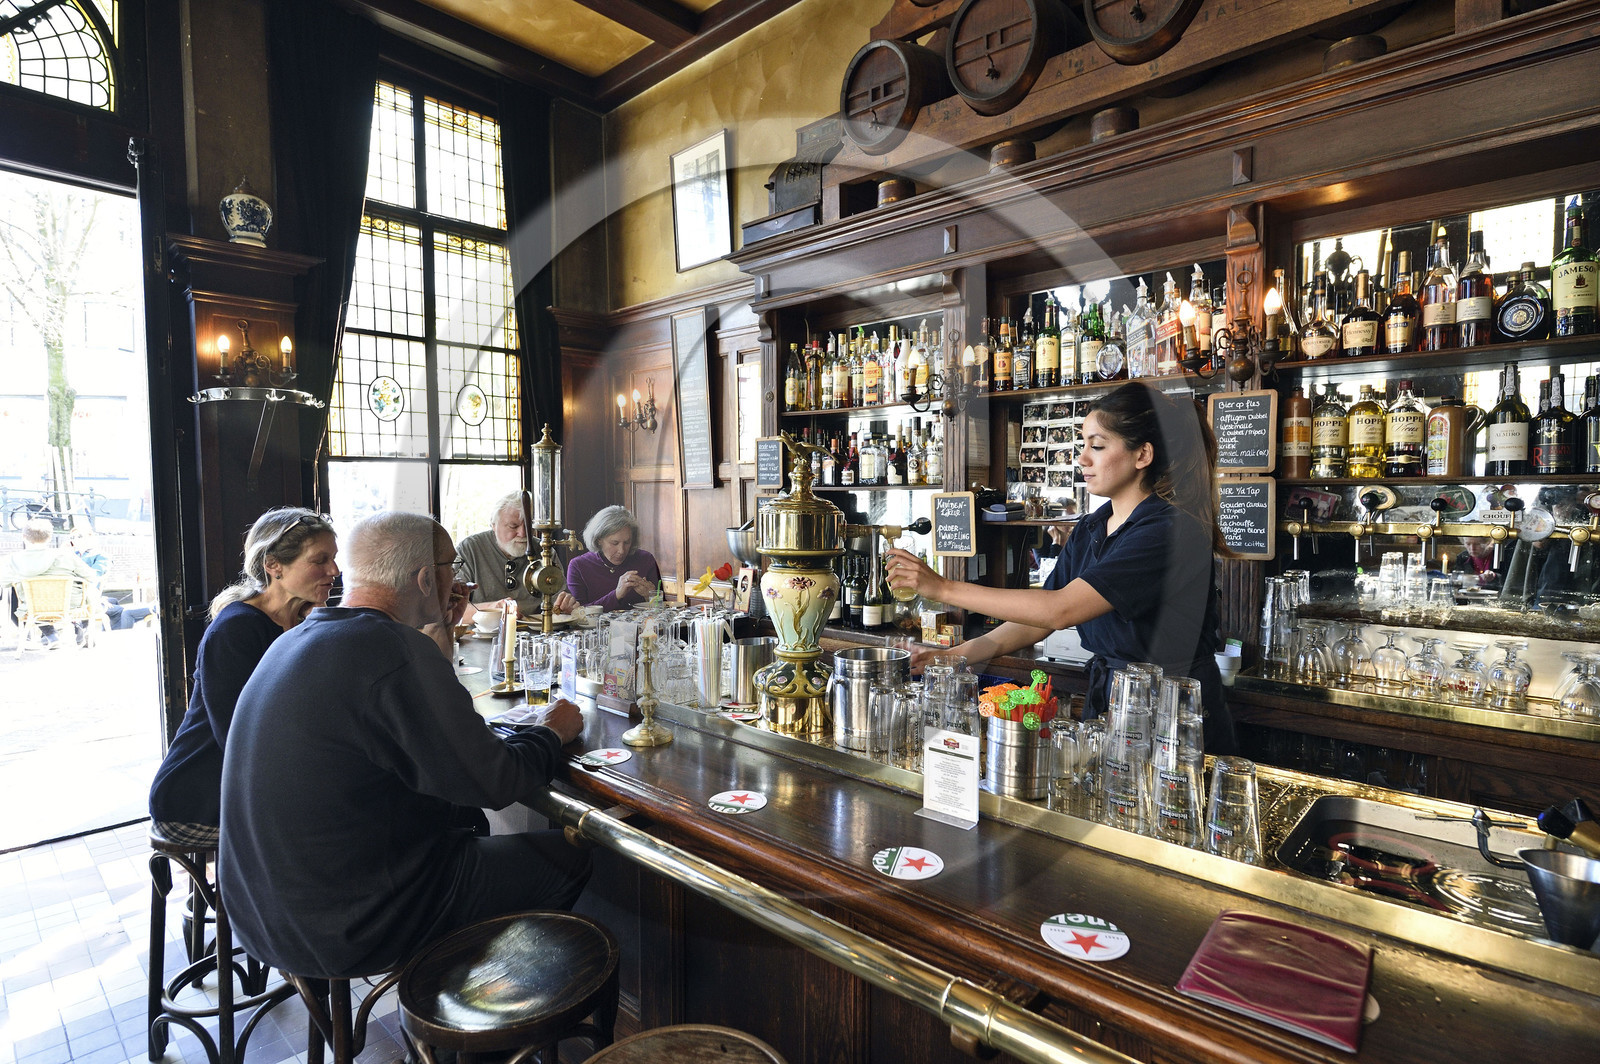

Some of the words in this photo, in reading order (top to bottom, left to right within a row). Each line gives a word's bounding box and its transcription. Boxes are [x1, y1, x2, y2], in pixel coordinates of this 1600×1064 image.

[1315, 420, 1344, 428] HOPPE
[1391, 415, 1423, 423] HOPPE
[1160, 772, 1188, 784] Heineken
[1159, 808, 1189, 820] Heineken
[1208, 821, 1234, 837] Heineken
